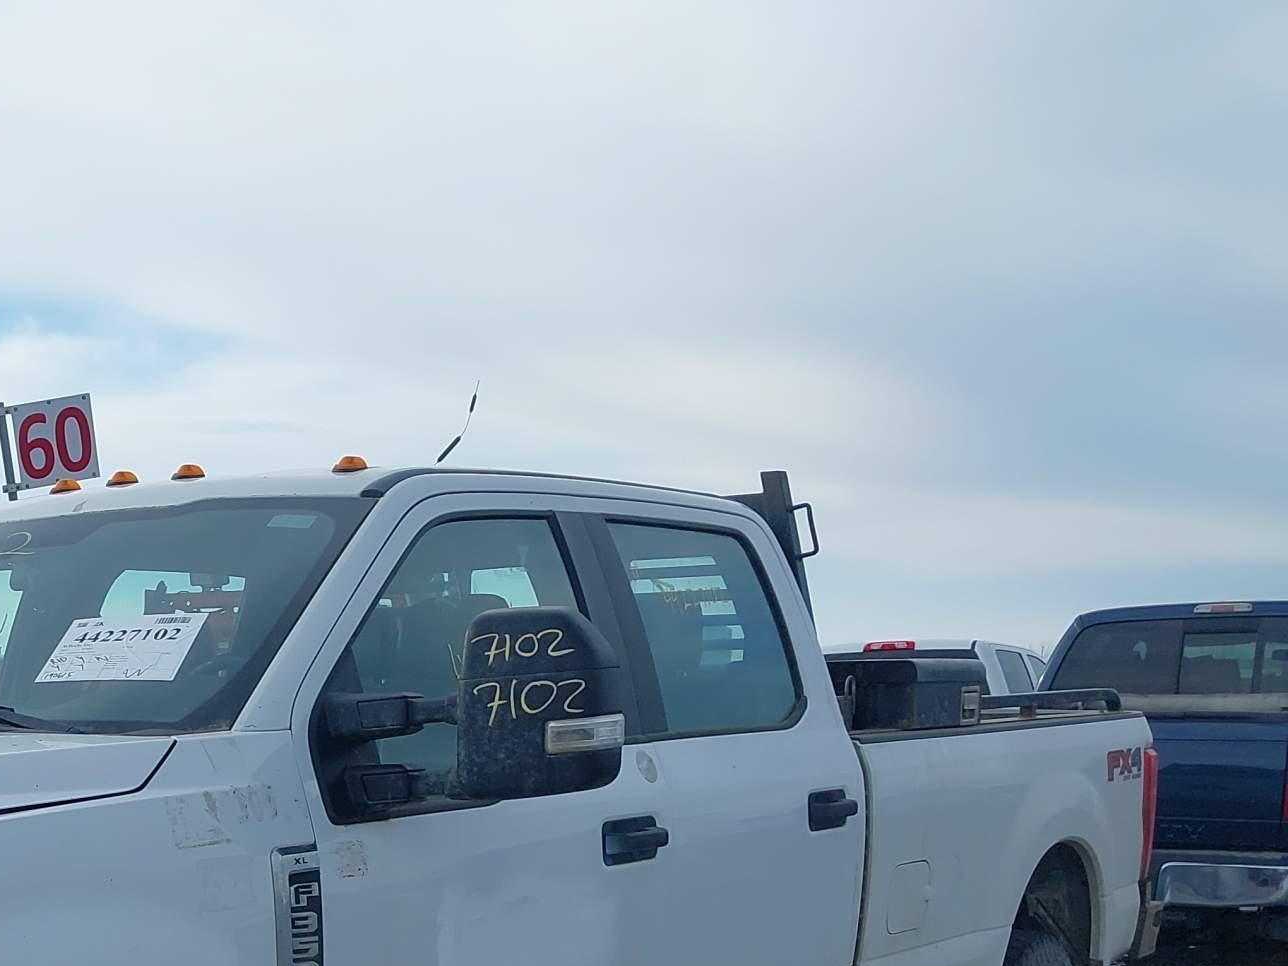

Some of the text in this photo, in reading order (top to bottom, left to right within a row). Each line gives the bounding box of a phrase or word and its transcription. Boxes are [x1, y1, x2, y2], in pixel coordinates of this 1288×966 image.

[18, 405, 93, 480] 60
[73, 627, 182, 643] 44227102
[470, 629, 575, 666] 7102
[473, 679, 586, 726] 7102
[1107, 747, 1141, 782] FX4
[293, 856, 309, 866] XL
